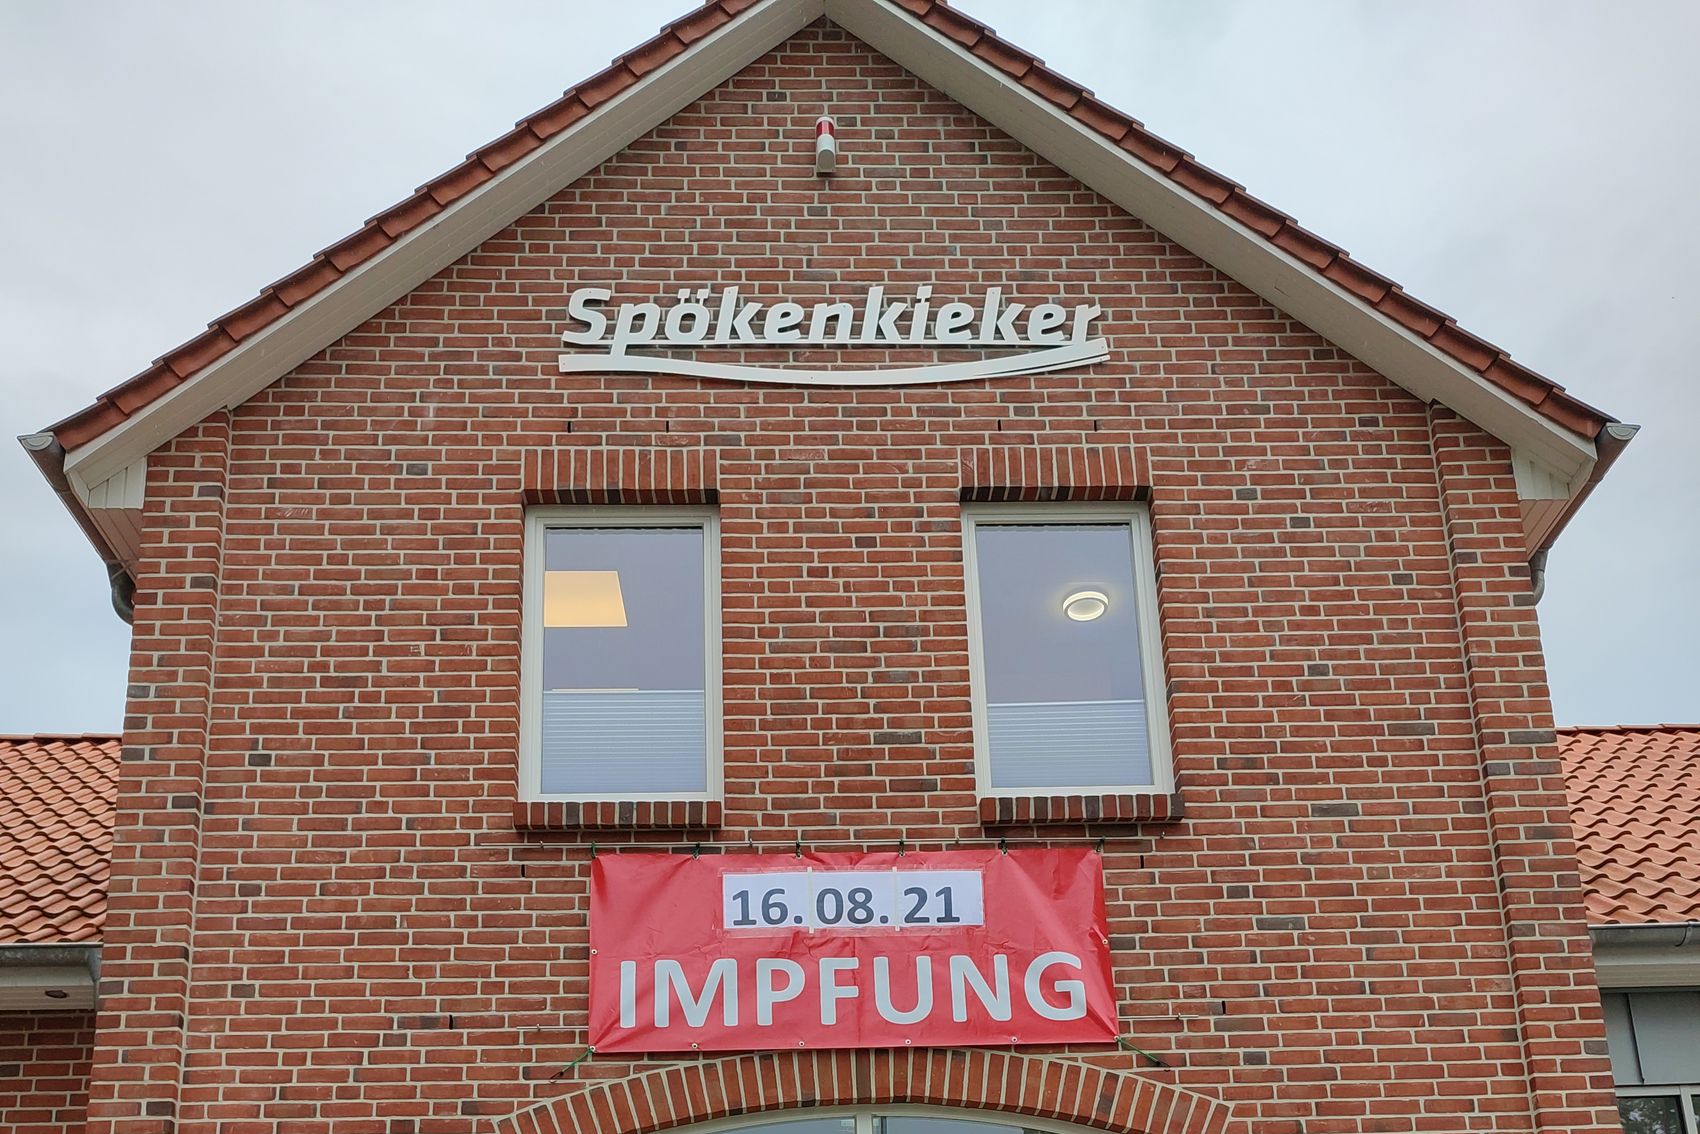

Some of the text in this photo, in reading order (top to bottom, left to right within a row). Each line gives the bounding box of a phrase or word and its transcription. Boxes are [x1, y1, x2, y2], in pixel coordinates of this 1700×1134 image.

[562, 286, 1102, 358] Spökenkieker
[731, 886, 961, 926] 16. 08. 21
[619, 950, 1088, 1029] IMPFUNG
